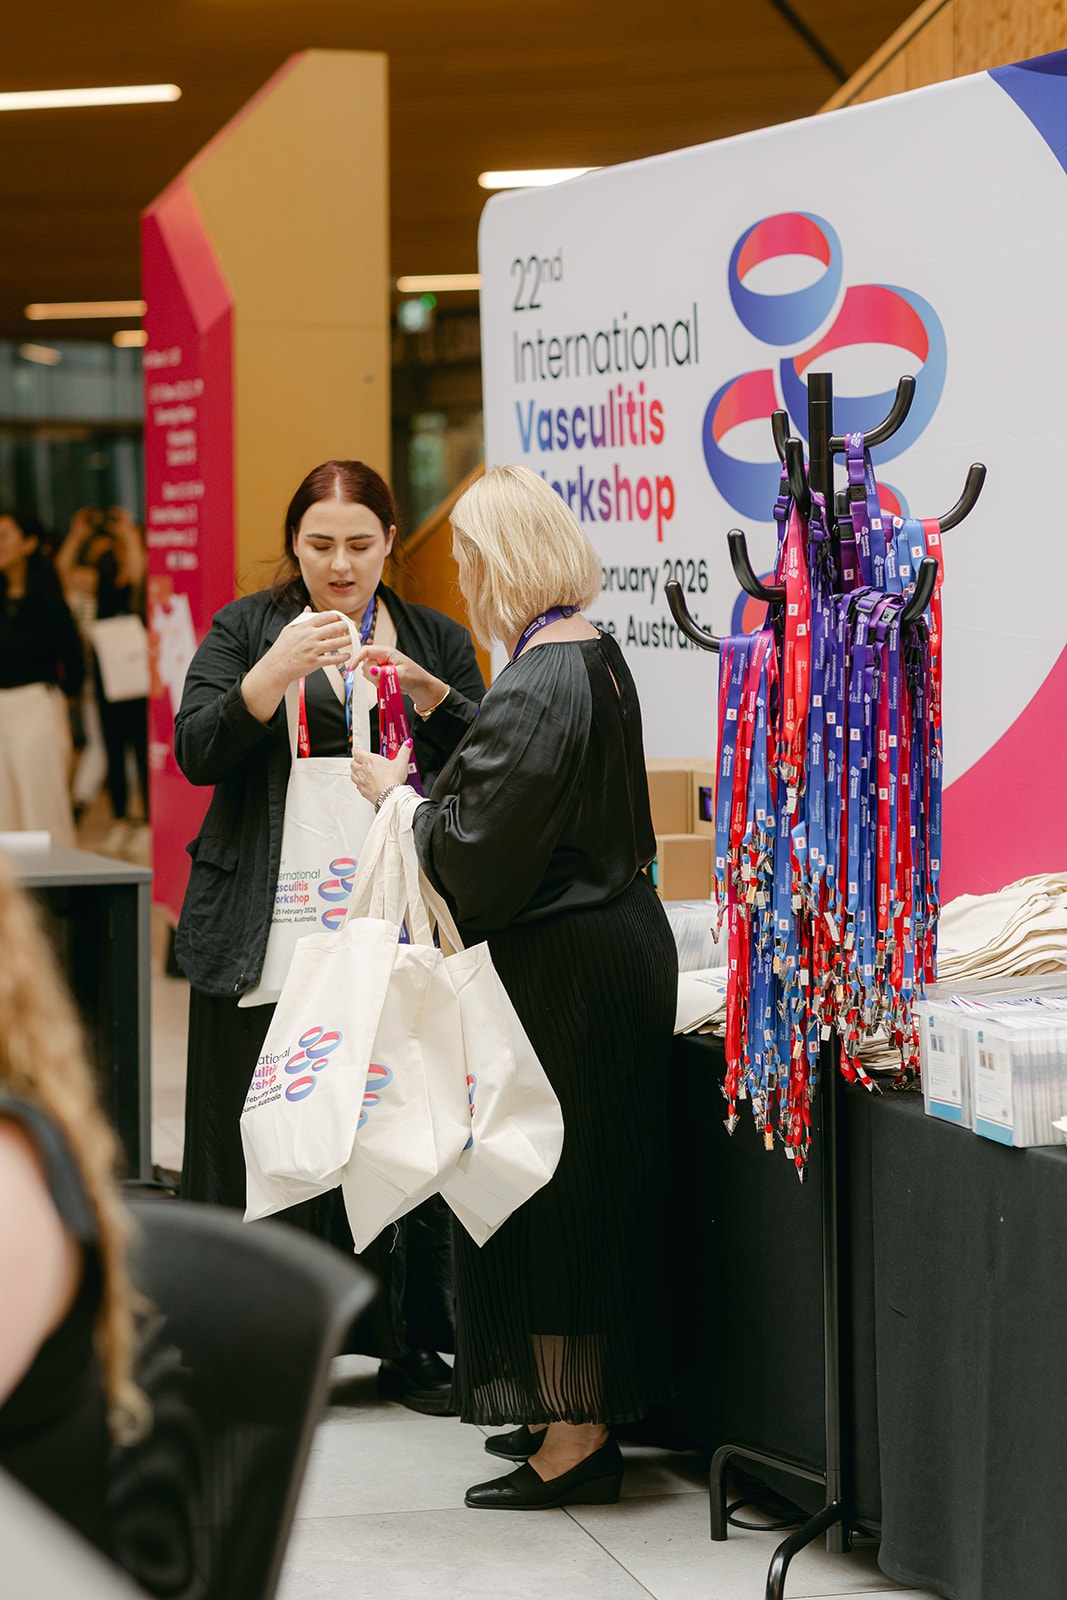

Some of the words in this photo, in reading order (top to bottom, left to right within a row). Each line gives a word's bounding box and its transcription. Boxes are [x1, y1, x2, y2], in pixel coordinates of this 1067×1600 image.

[511, 248, 563, 311] 22nd
[513, 302, 699, 383] International
[516, 382, 665, 453] Vasculitis
[541, 463, 675, 542] rkshop
[663, 558, 709, 593] 2026
[275, 893, 309, 905] orkshop
[280, 869, 320, 880] ernational
